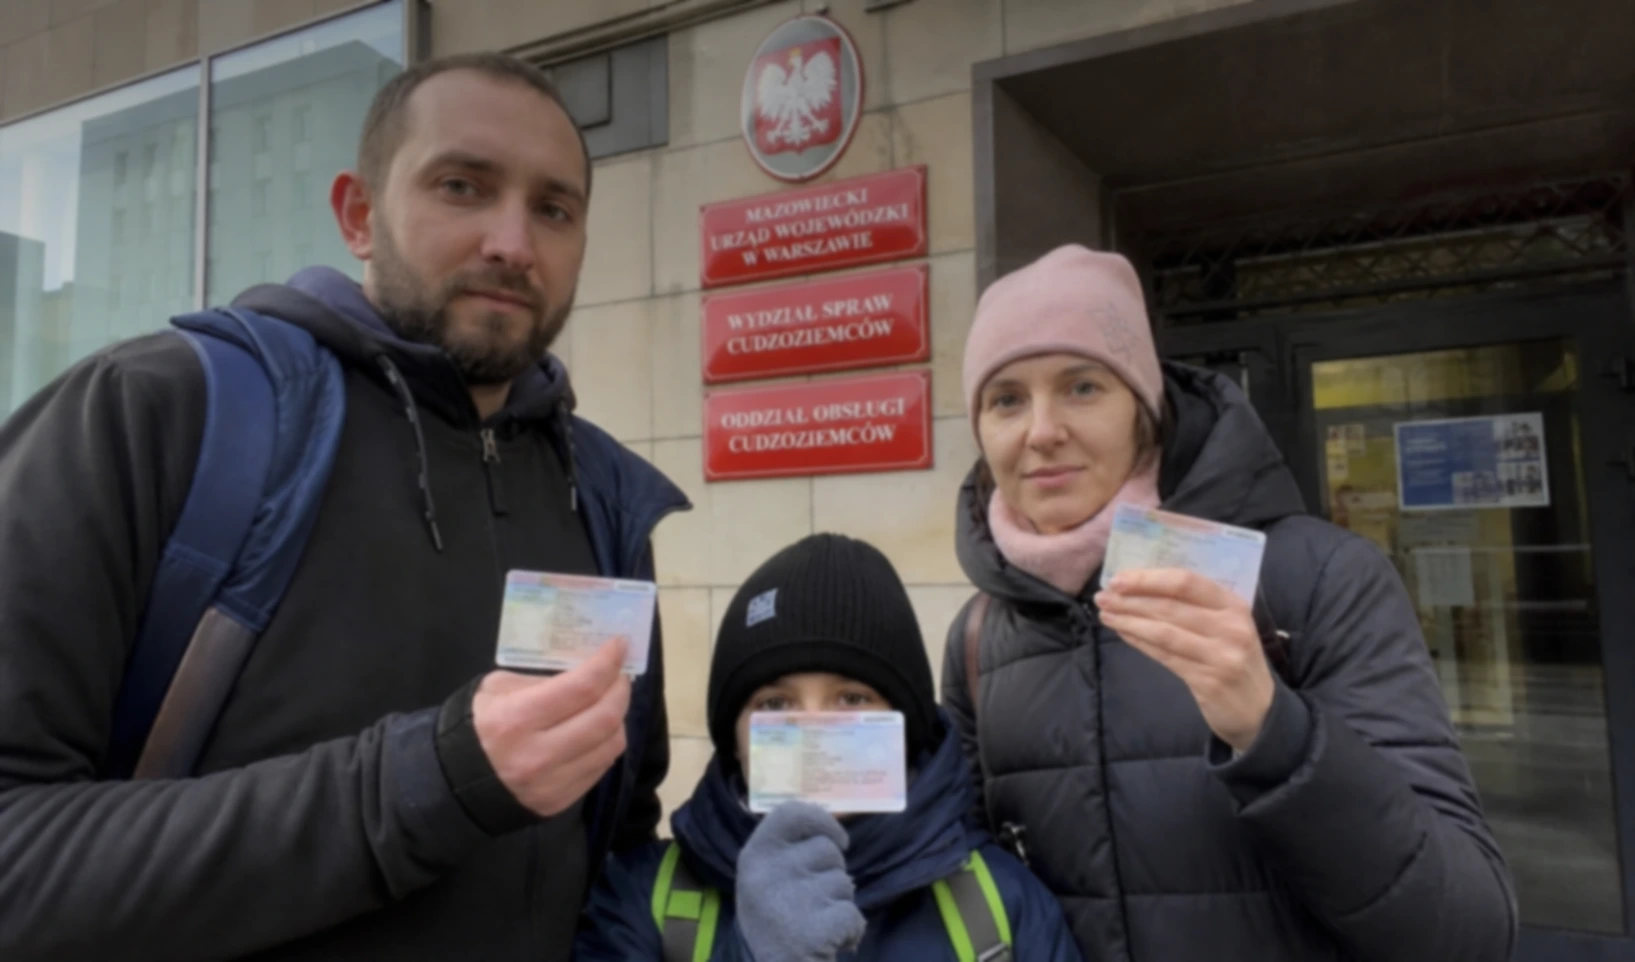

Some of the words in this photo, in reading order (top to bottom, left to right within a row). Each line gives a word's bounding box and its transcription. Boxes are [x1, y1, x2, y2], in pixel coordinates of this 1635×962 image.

[745, 188, 868, 223] MAZOWIECKI
[710, 228, 771, 250] URZĄD
[774, 203, 909, 239] WOJEWÓDZKI
[742, 252, 758, 266] W
[763, 231, 873, 262] WARSZAWIE
[727, 304, 818, 330] WYDZIAŁ
[822, 293, 894, 317] SPRAW
[727, 318, 895, 355] CUDZOZIEMCÓW
[720, 407, 809, 429] ODDZIAŁ
[812, 398, 906, 422] OBSŁUGI
[728, 422, 896, 453] CUDZOZIEMCÓW
